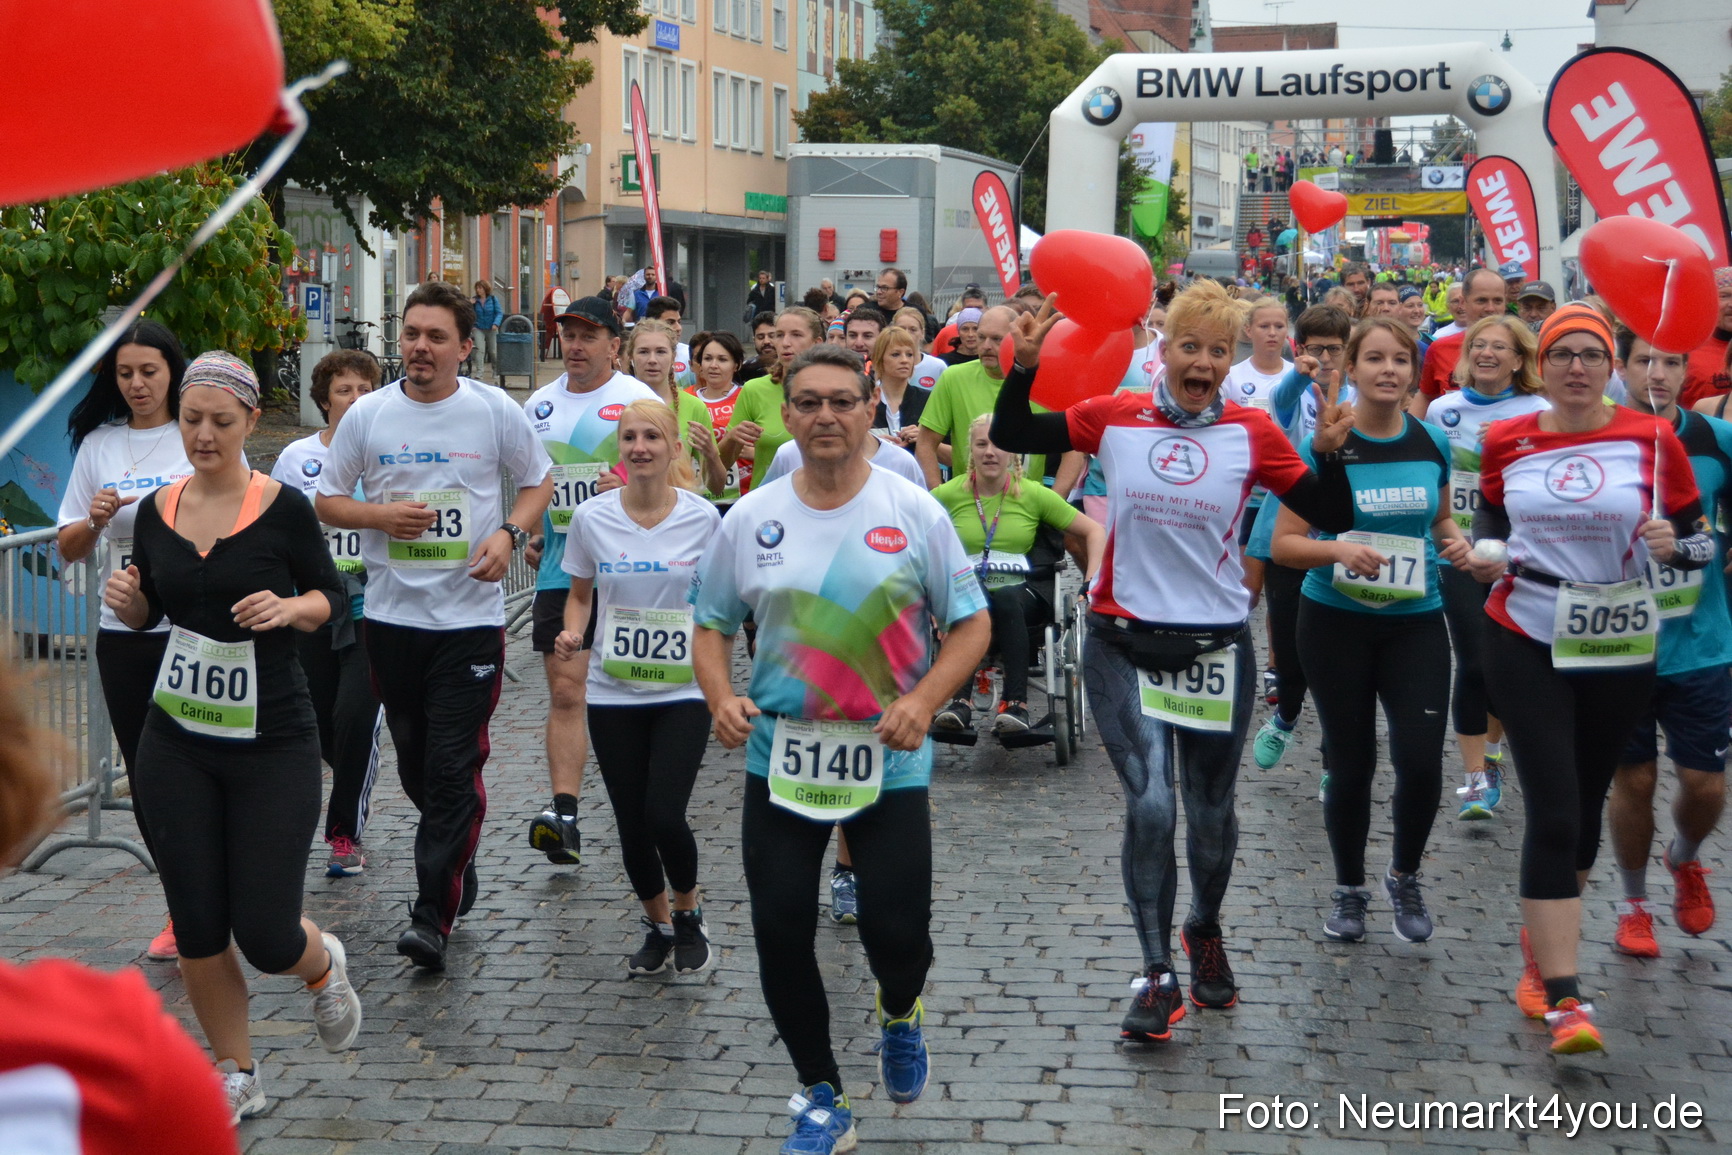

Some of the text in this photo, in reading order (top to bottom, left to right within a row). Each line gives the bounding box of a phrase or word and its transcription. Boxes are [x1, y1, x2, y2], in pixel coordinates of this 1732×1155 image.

[1136, 61, 1452, 100] BMW Laufsport
[1570, 81, 1715, 260] EWE
[1364, 198, 1401, 211] ZIEL
[1477, 169, 1532, 263] REWE
[979, 185, 1017, 284] REWE
[308, 291, 319, 307] P
[602, 408, 623, 416] Herv
[568, 466, 601, 475] BOCK
[420, 491, 462, 502] BOCK
[1356, 486, 1427, 504] HUBER
[1453, 487, 1481, 511] 50
[1145, 505, 1164, 514] Heck
[1171, 508, 1182, 516] Dr.
[1373, 502, 1426, 510] TECHNOLOGY
[423, 508, 462, 538] 43
[559, 513, 573, 524] Chri
[1134, 514, 1206, 531] Leistungsdiagnostik
[870, 532, 904, 548] Hervis
[1377, 536, 1417, 550] BOCK
[407, 546, 446, 558] Tassilo
[756, 552, 784, 562] PARTL
[986, 576, 1005, 584] ena
[1656, 594, 1681, 608] trick
[645, 611, 687, 623] BOCK
[1567, 600, 1648, 635] 5055
[202, 641, 248, 658] BOCK
[613, 626, 686, 660] 5023
[1579, 642, 1630, 654] Carmen
[168, 653, 248, 702] 5160
[630, 666, 665, 680] Maria
[181, 702, 222, 723] Carina
[1164, 696, 1204, 716] Nadine
[821, 722, 873, 734] BOCK
[782, 738, 872, 782] 5140
[796, 786, 852, 806] Gerhard
